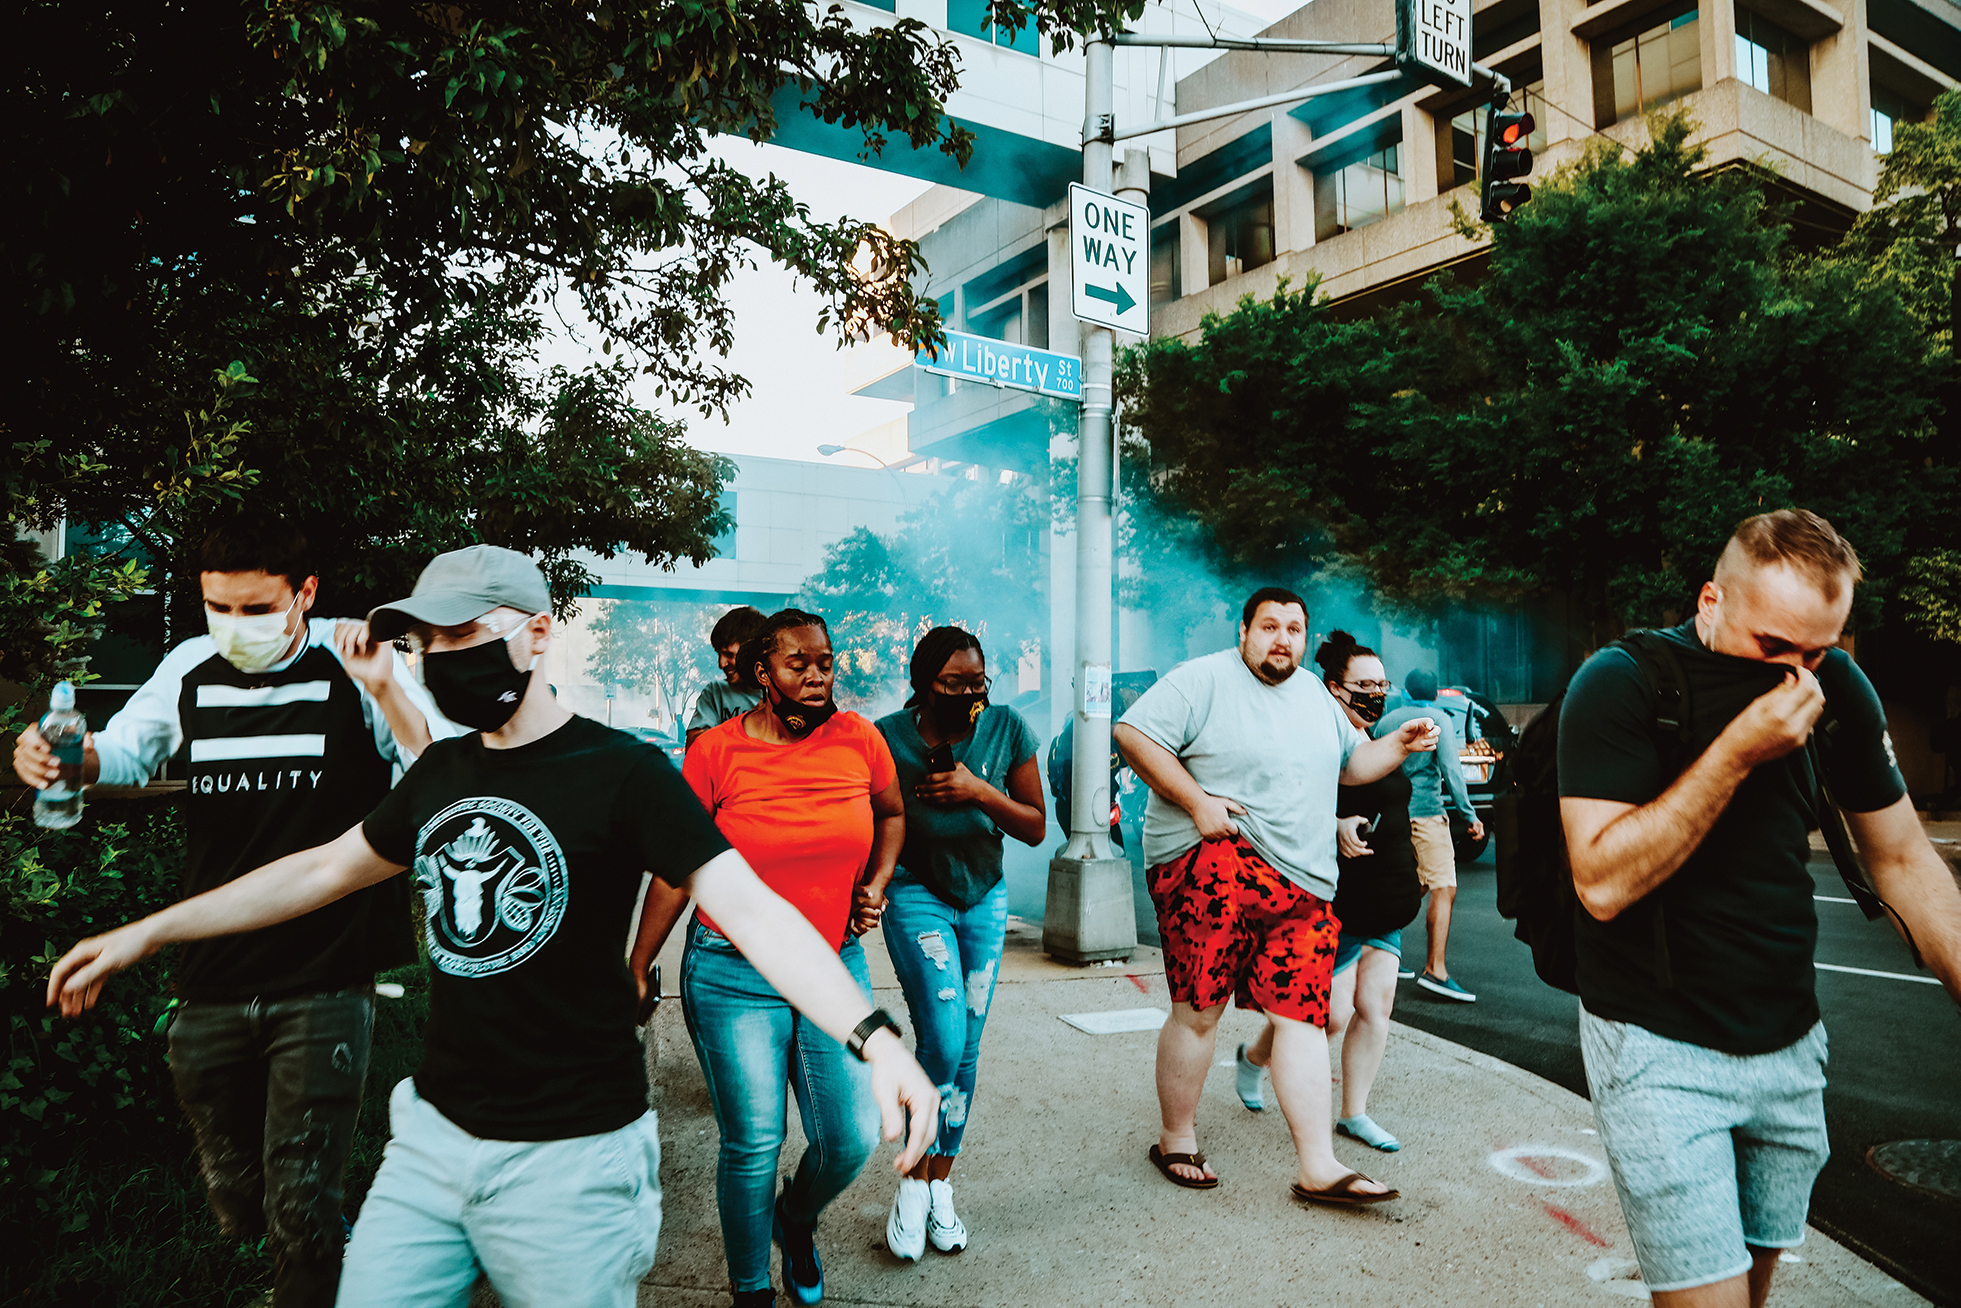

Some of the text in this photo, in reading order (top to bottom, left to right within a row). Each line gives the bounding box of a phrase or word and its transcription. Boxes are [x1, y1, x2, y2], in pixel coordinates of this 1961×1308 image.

[1422, 0, 1464, 41] LEFT
[1421, 30, 1465, 75] TURN
[1084, 201, 1136, 242] ONE
[1083, 235, 1137, 275] WAY
[943, 340, 1072, 390] W Liberty St
[1056, 377, 1074, 391] 700
